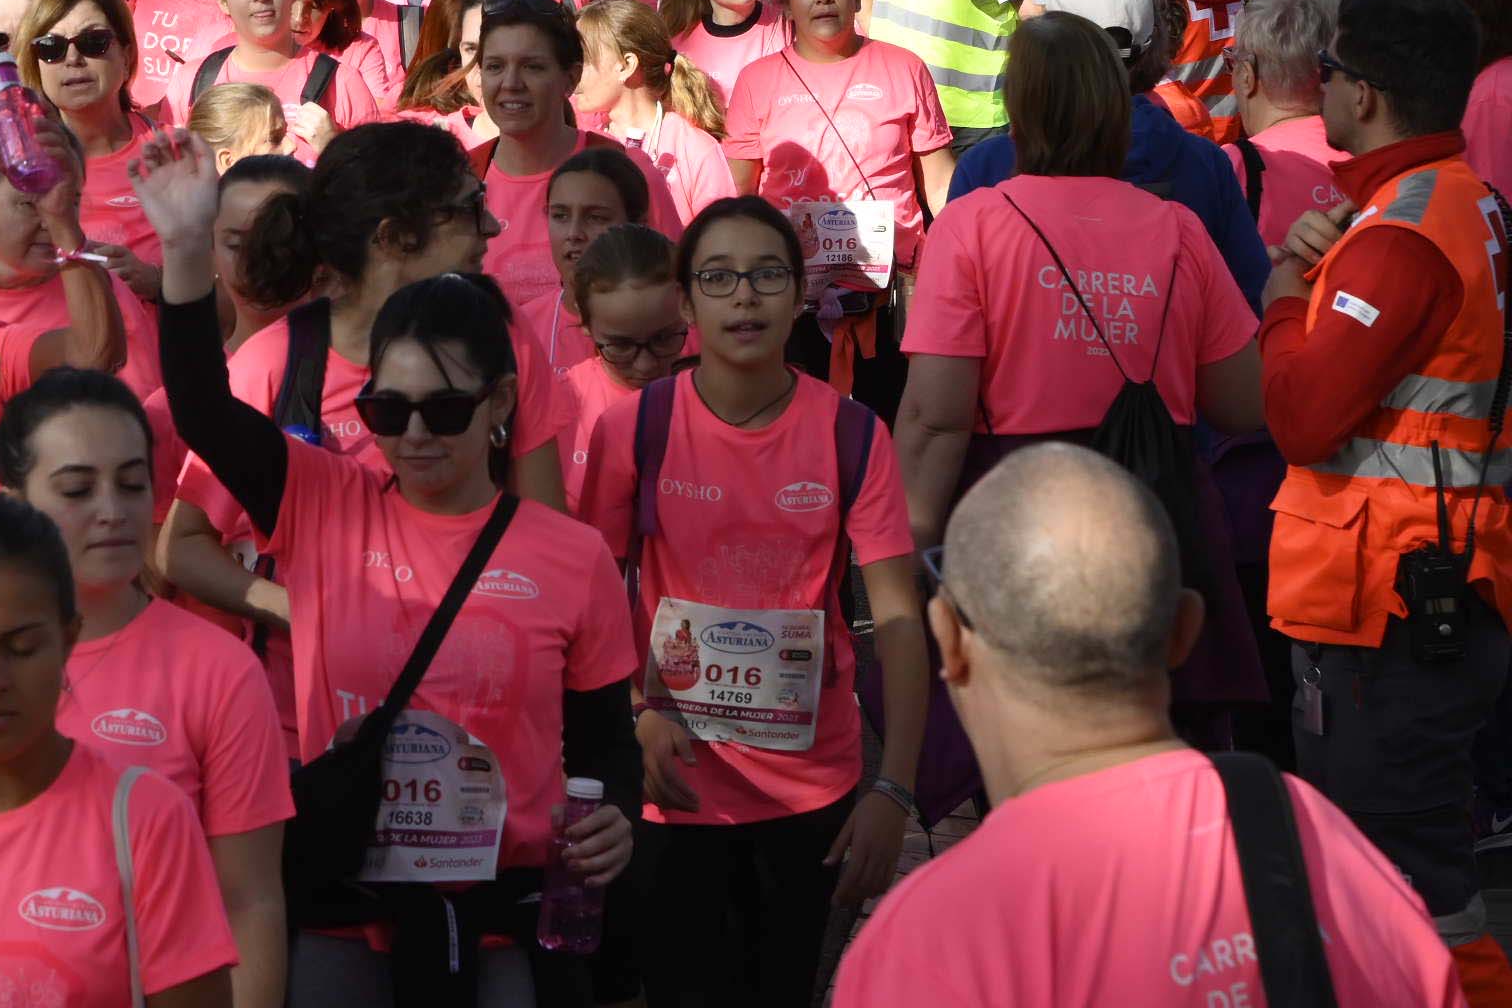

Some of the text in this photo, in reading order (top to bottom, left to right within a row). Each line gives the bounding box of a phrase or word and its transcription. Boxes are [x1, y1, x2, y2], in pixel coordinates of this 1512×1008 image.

[151, 10, 179, 28] TU
[822, 237, 857, 251] 016
[825, 254, 853, 262] 12186
[1038, 265, 1159, 297] CARRERA
[1061, 293, 1136, 320] DE LA
[660, 478, 722, 503] OYSHO
[707, 632, 769, 649] ASTURIANA
[780, 630, 812, 641] SUMA
[705, 663, 762, 687] 016
[709, 689, 753, 704] 14769
[710, 706, 724, 716] DE
[725, 709, 739, 718] LA
[739, 710, 774, 721] MUJER
[98, 718, 161, 743] ASTURIANA
[748, 728, 801, 742] Santander
[382, 778, 442, 803] 016
[428, 855, 485, 870] Santander
[26, 894, 98, 926] ASTURIANA
